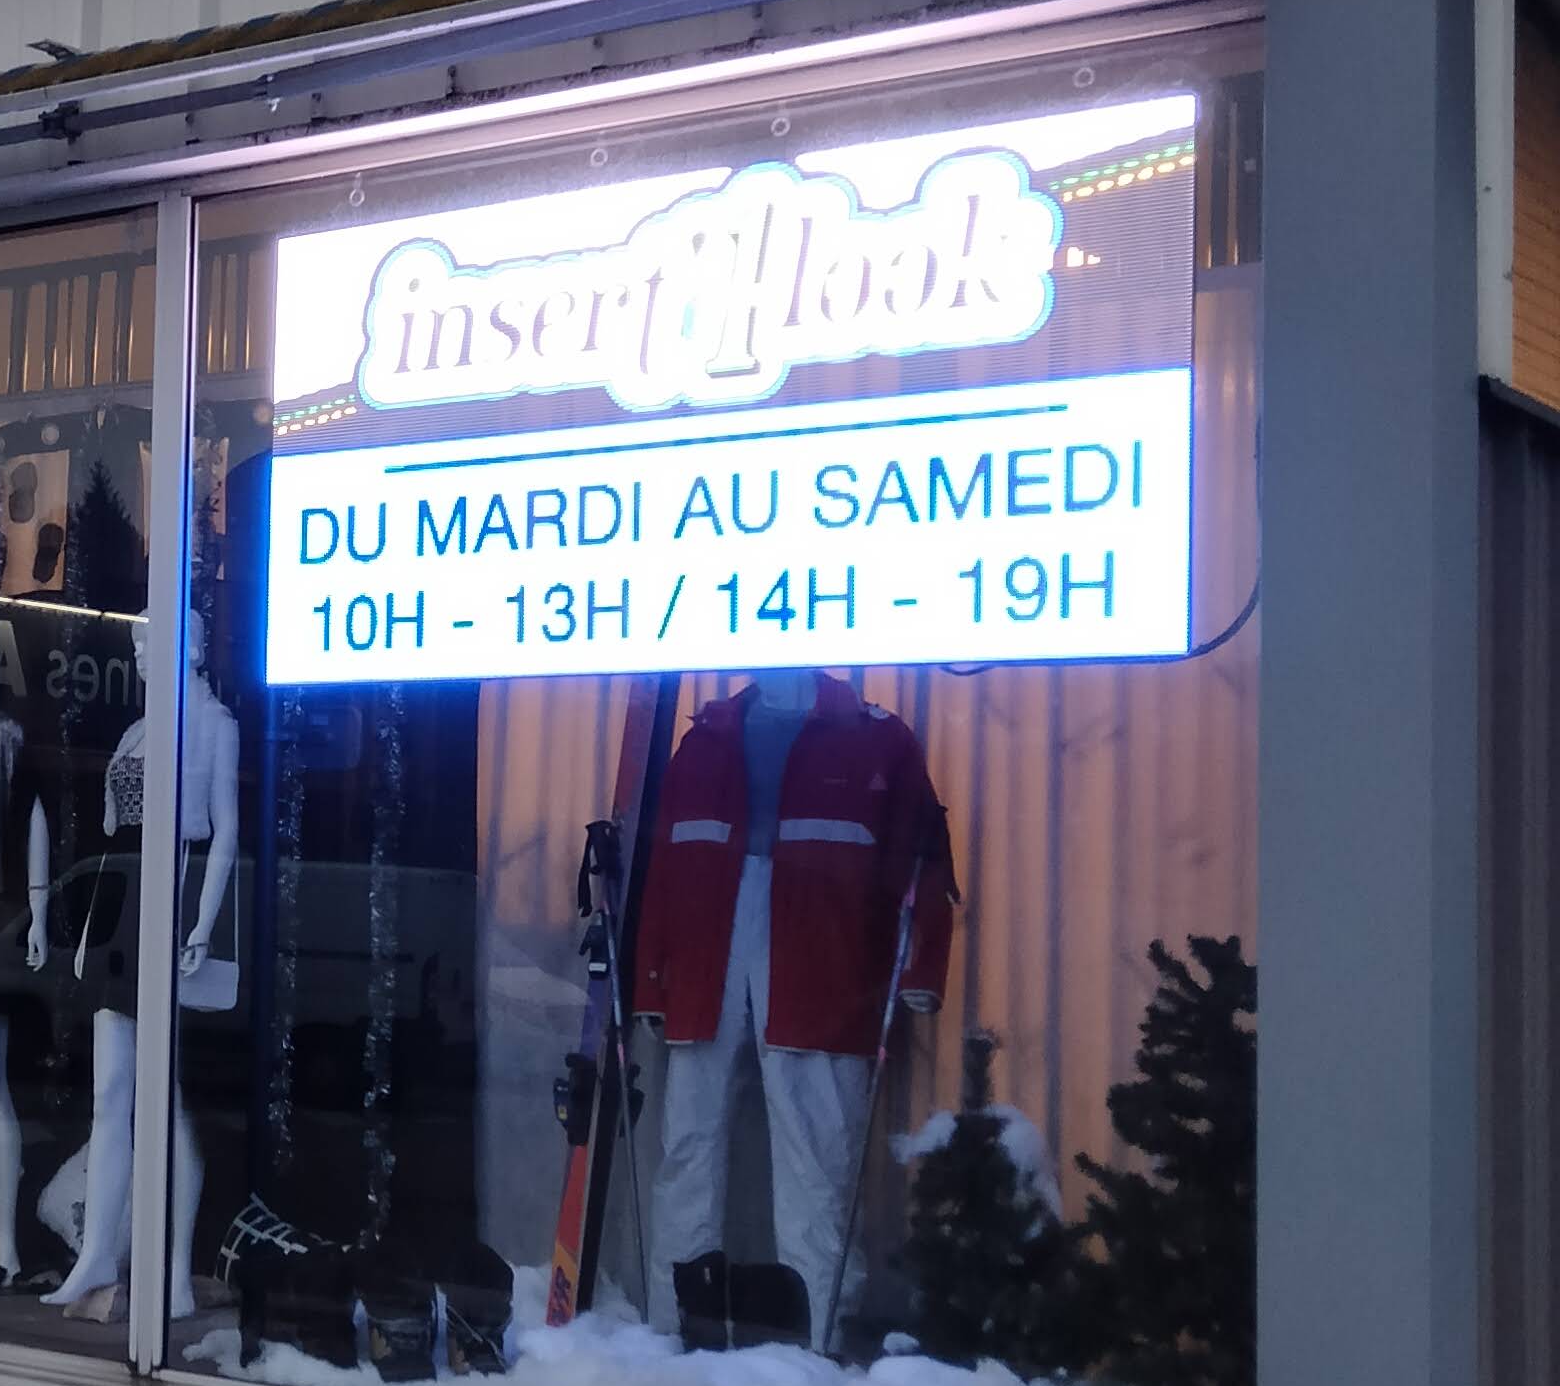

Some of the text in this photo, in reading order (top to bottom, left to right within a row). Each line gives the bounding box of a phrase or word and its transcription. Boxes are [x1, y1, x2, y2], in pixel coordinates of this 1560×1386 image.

[299, 440, 1142, 564] DU MARDI AU SAMEDI
[313, 590, 425, 651] 10H
[506, 578, 630, 643] 13H
[717, 564, 856, 634] 14H
[958, 550, 1115, 623] 19H
